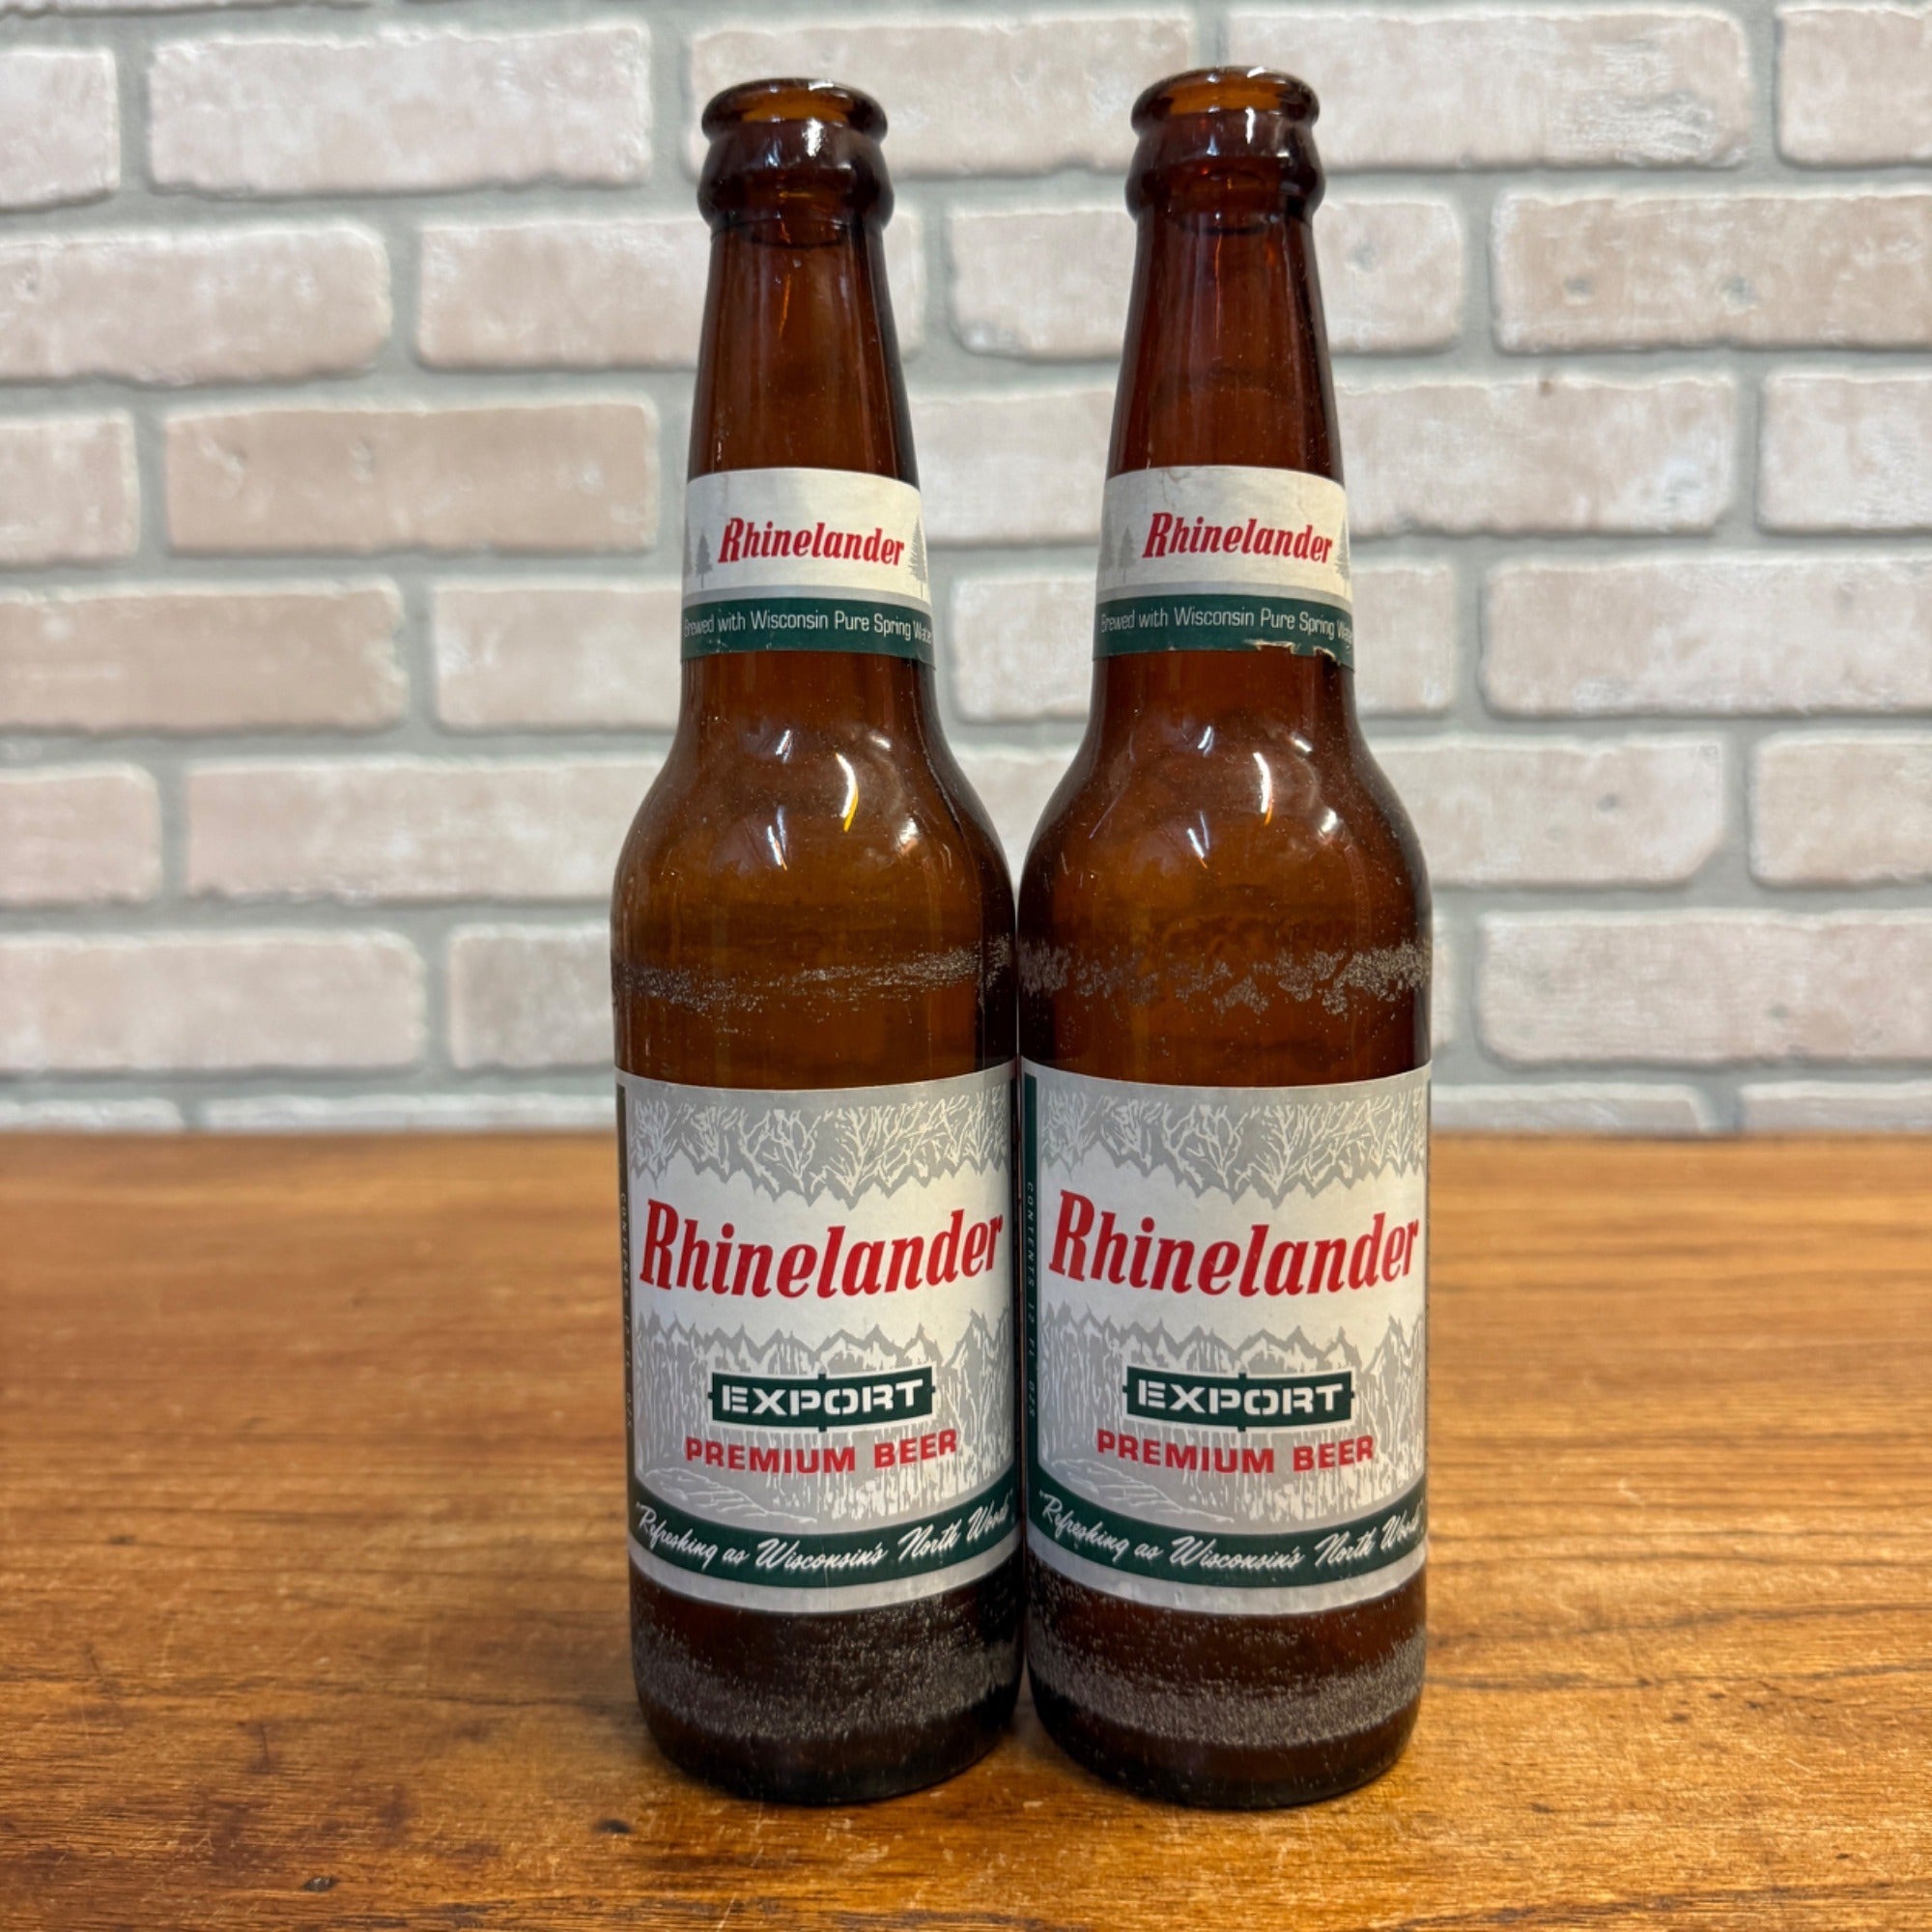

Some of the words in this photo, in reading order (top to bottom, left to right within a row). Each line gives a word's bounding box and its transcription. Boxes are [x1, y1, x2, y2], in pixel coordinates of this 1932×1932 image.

[718, 517, 905, 566] Rhinelander
[1142, 512, 1333, 563] Rhinelander
[717, 611, 746, 633] with
[750, 609, 829, 630] Wisconsin
[834, 610, 869, 632] Pure
[873, 612, 911, 641] Spring
[1138, 608, 1168, 628] with
[1174, 606, 1255, 627] Wisconsin
[1261, 607, 1295, 630] Pure
[1298, 611, 1334, 640] Spring
[639, 1198, 1004, 1299] Rhinelander
[1048, 1189, 1420, 1298] Rhinelander
[722, 1378, 924, 1417] EXPORT
[1137, 1378, 1345, 1416] EXPORT
[685, 1435, 856, 1474] PREMIUM
[873, 1429, 957, 1469] BEER
[1096, 1429, 1275, 1474] PREMIUM
[1293, 1435, 1375, 1473] BEER
[722, 1548, 750, 1563] as
[754, 1537, 889, 1570] Wisconsin's
[897, 1518, 962, 1562] North
[1133, 1543, 1164, 1559] as
[1169, 1535, 1306, 1570] Wisconsin's
[1314, 1526, 1378, 1567] North
